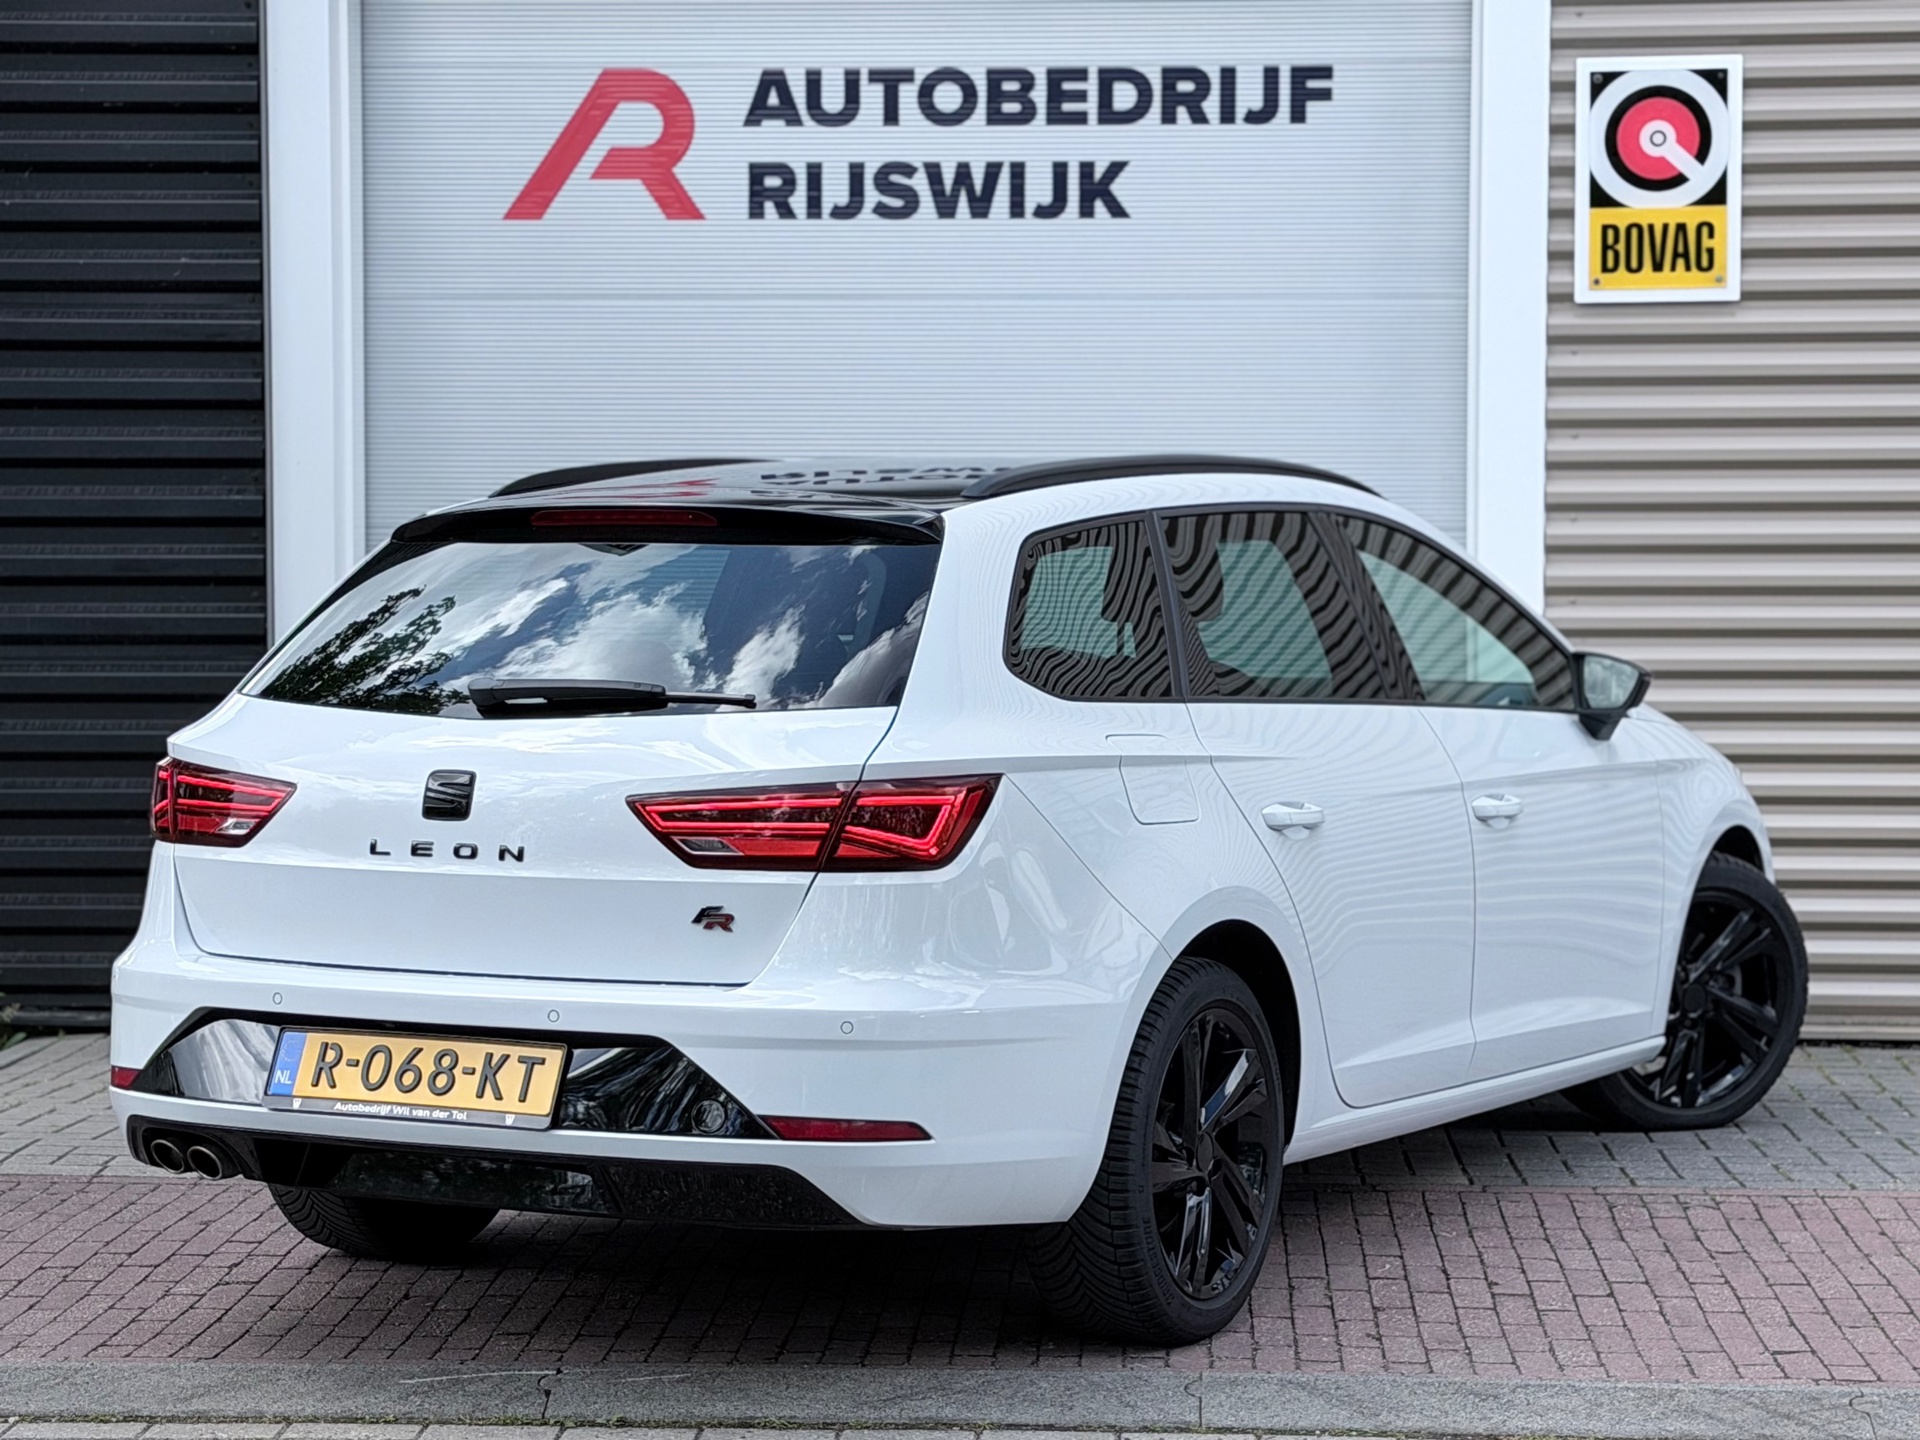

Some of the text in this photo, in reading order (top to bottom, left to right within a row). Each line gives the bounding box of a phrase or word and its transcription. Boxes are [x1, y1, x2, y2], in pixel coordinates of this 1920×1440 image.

[742, 66, 1334, 127] AUTOBEDRIJF
[748, 161, 1132, 220] RIJSWIJK
[1601, 221, 1715, 274] BOVAG
[369, 838, 525, 863] LEON
[691, 905, 736, 932] FR
[274, 1069, 293, 1085] NL
[310, 1041, 546, 1103] R-068-KT
[333, 1101, 468, 1121] Autobedrijf Wil van der Tol
